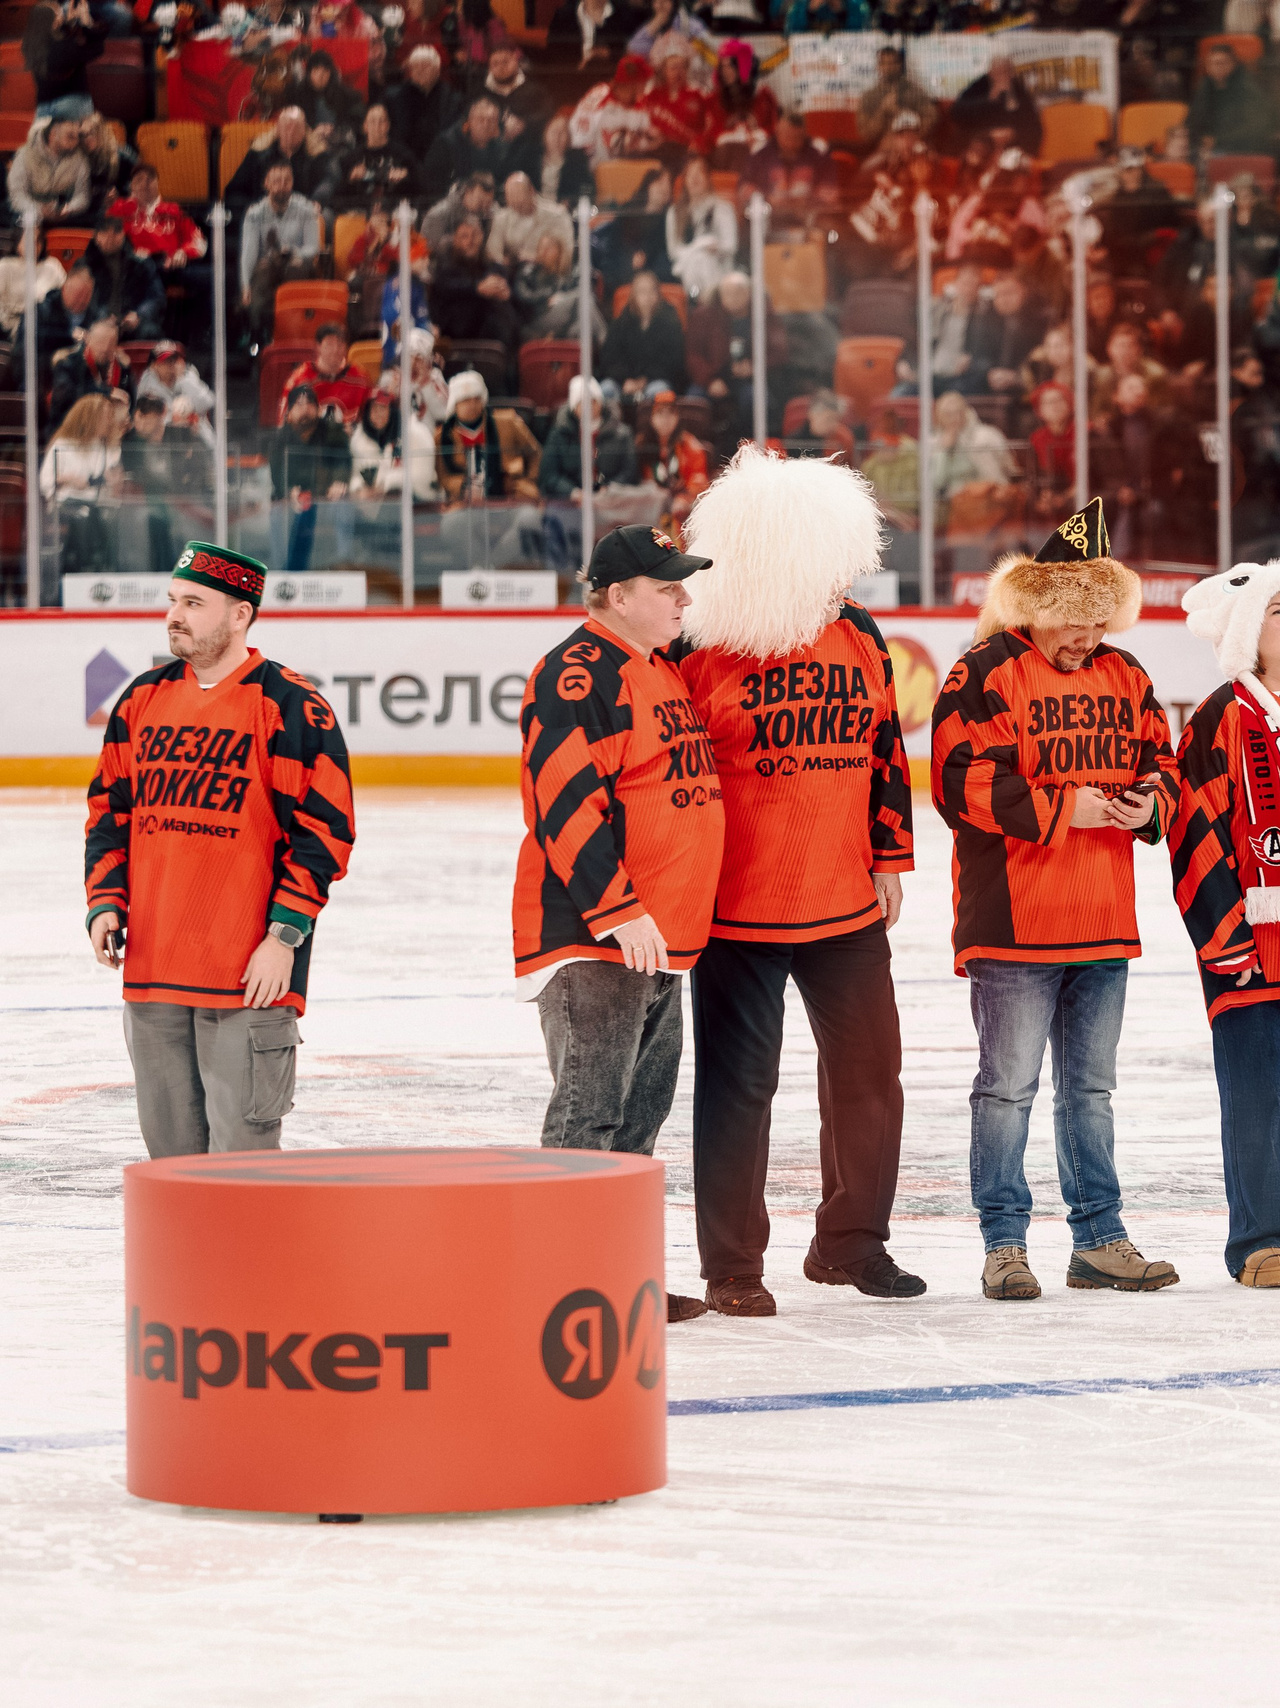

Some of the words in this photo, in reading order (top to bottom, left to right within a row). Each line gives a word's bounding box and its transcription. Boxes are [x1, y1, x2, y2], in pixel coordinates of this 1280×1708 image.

[740, 661, 868, 710] ЗВЕЗДА
[747, 704, 875, 752] ХОККЕЯ
[1027, 693, 1135, 736] ЗВЕЗДА
[135, 725, 255, 772] ЗВЕЗДА
[802, 756, 869, 772] Маркет
[1032, 734, 1142, 778] ХОККЕЯ
[131, 768, 252, 814] ХОККЕЯ
[160, 818, 241, 839] Маркет
